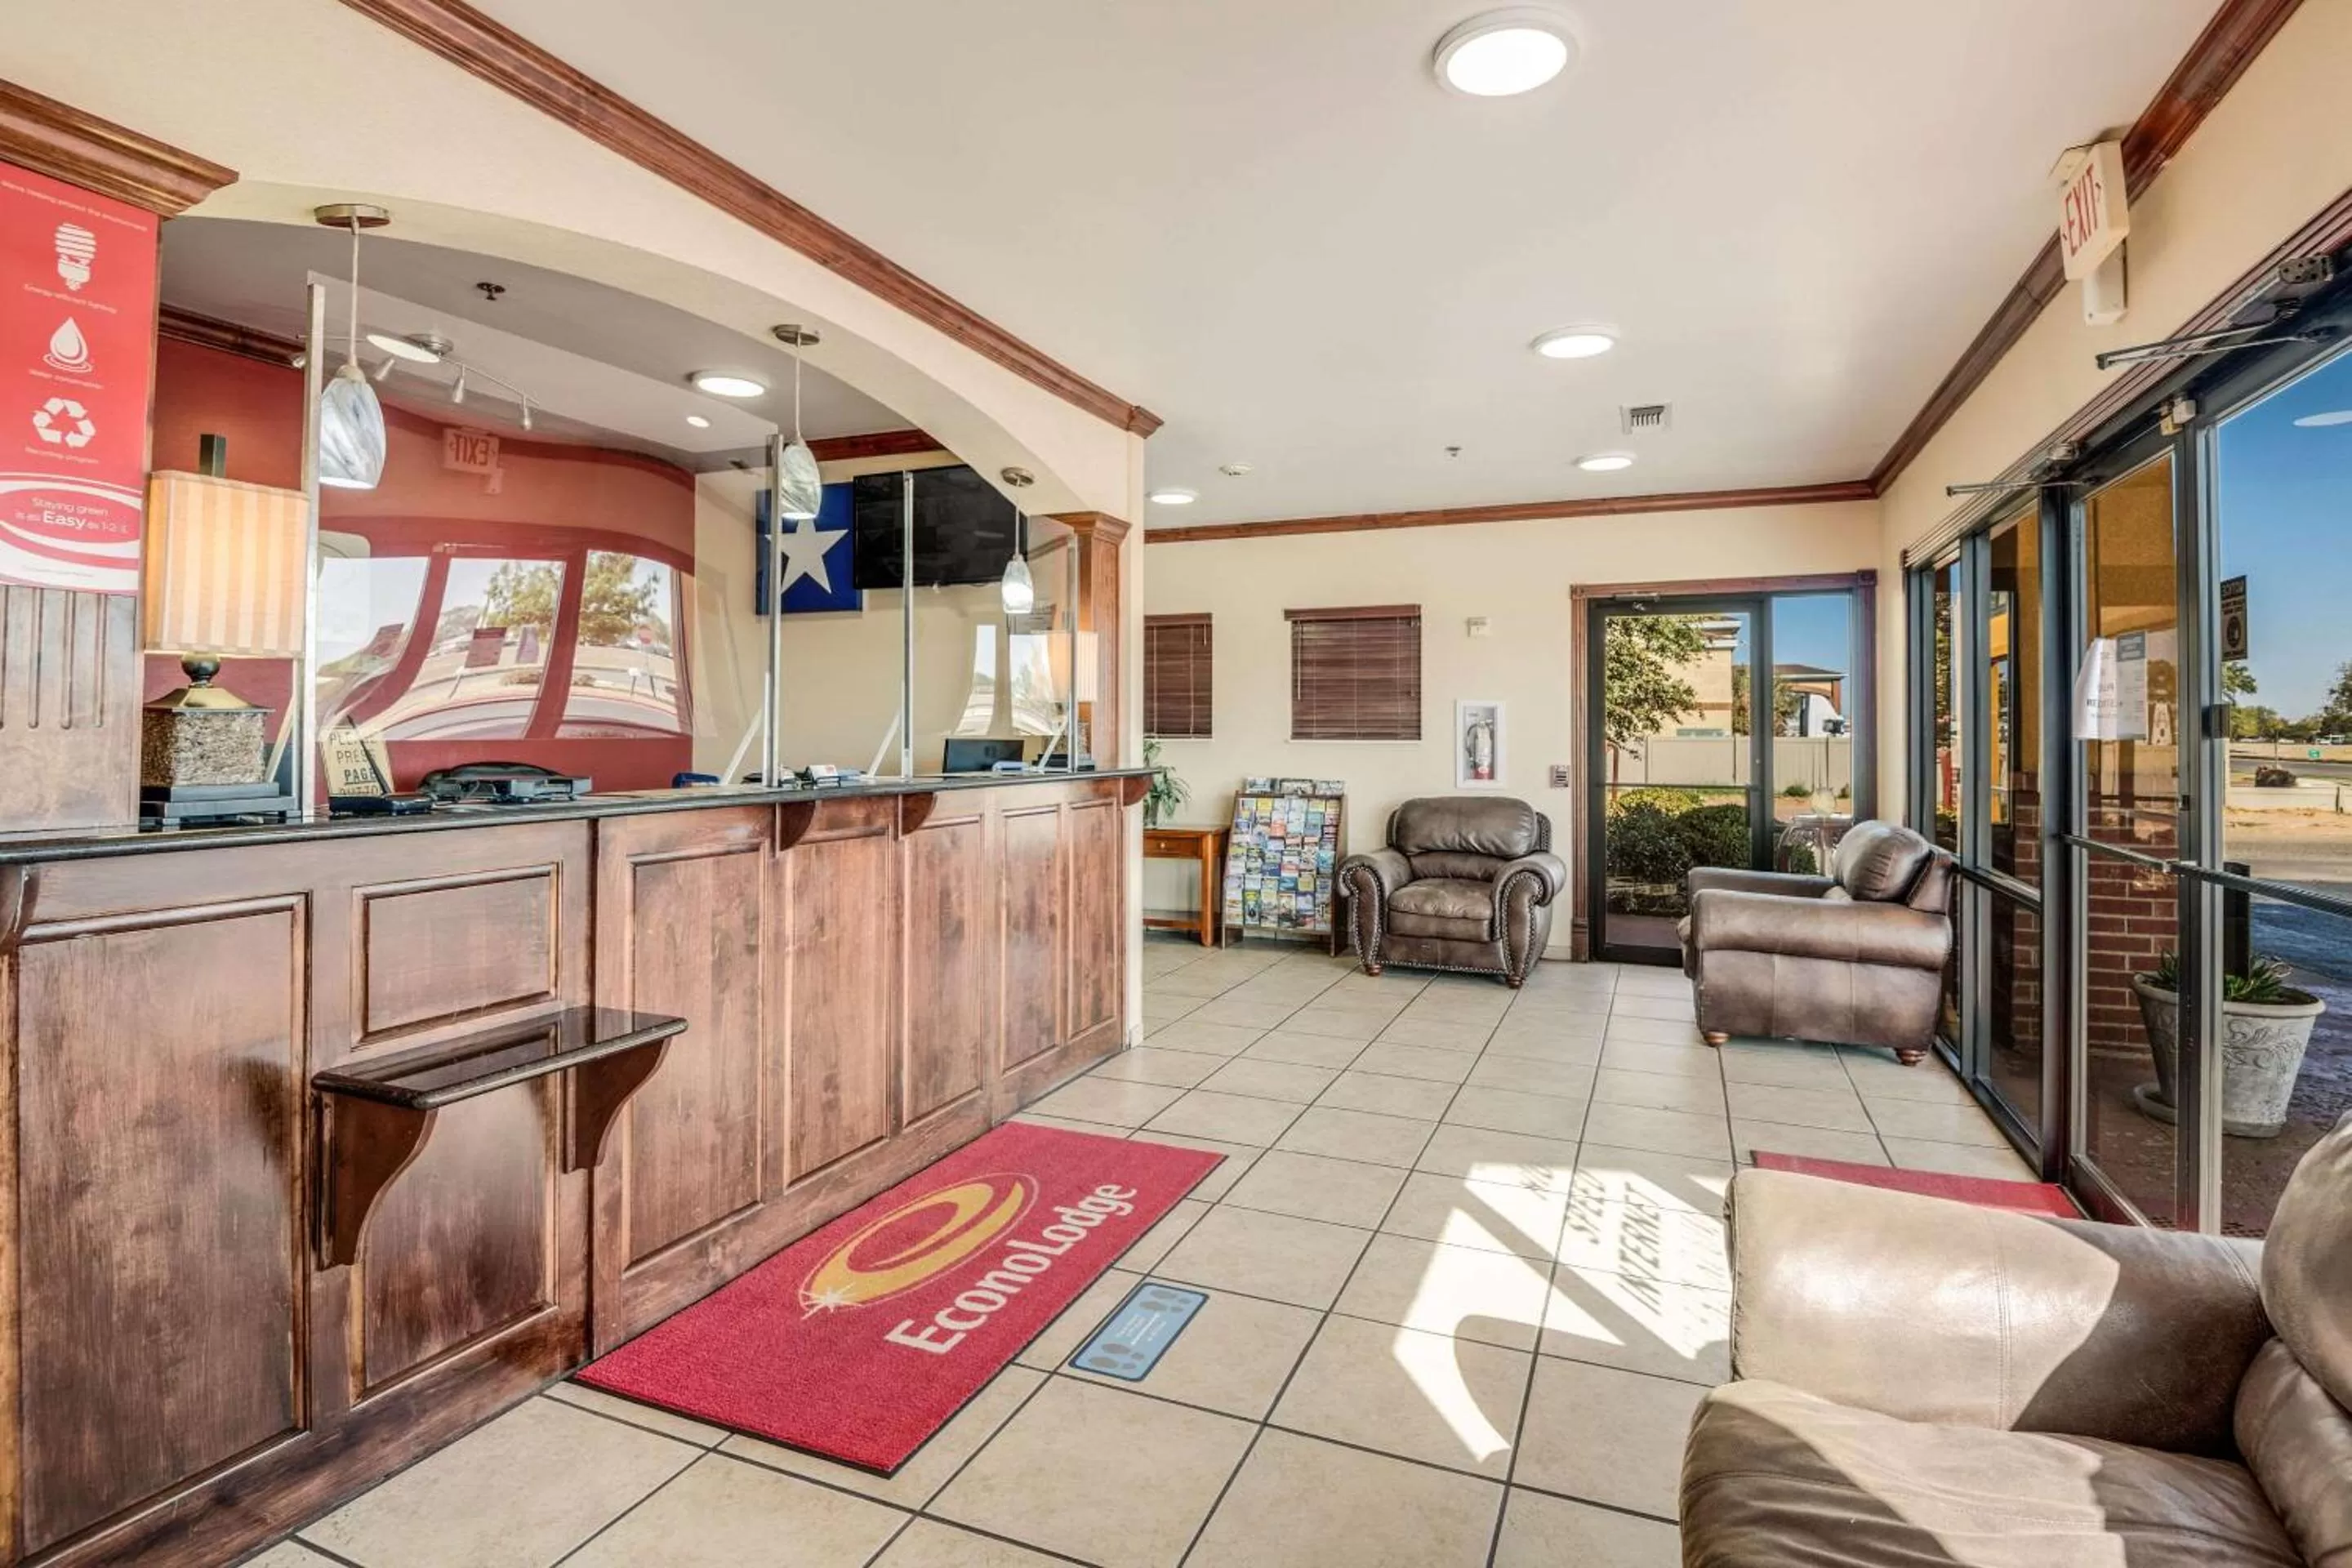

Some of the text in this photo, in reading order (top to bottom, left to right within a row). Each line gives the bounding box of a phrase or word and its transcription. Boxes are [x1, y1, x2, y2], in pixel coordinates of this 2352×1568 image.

[2065, 163, 2098, 257] EXIT
[43, 510, 87, 529] Easy
[1566, 1167, 1605, 1245] SPEED
[1617, 1180, 1662, 1316] INTERNET
